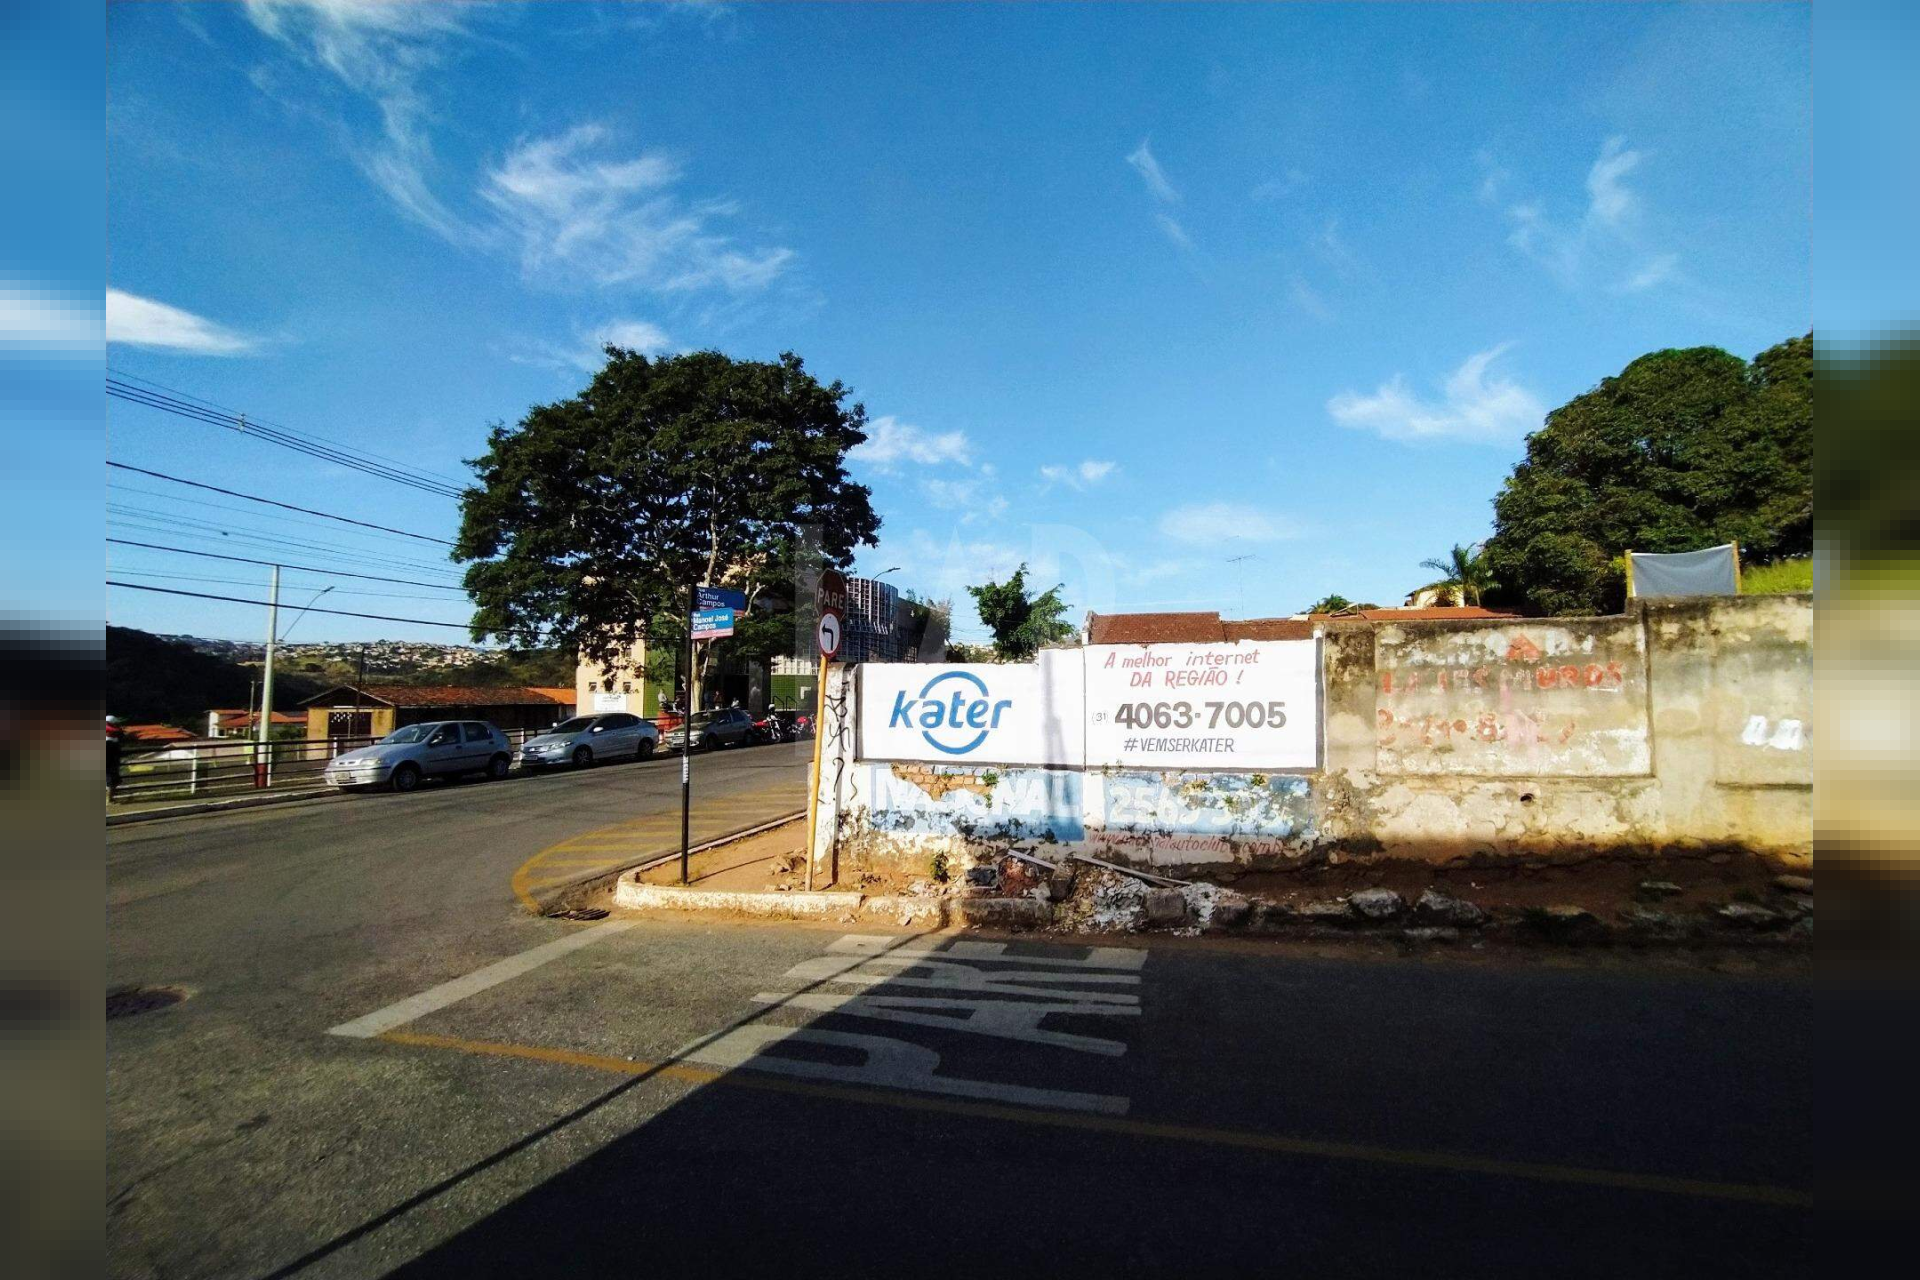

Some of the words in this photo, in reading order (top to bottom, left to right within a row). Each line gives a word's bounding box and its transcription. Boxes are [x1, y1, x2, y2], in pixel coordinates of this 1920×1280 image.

[697, 592, 719, 600] Arthur
[697, 598, 725, 607] Campos
[818, 587, 845, 610] PARE
[1104, 652, 1116, 669] A
[1122, 651, 1172, 668] melhor
[1186, 649, 1260, 666] internet
[1130, 671, 1152, 687] DA
[1165, 667, 1228, 689] REGIÃO
[888, 690, 1013, 729] kater
[1123, 737, 1235, 753] #VEMSERKATER
[668, 934, 1149, 1116] PARE
